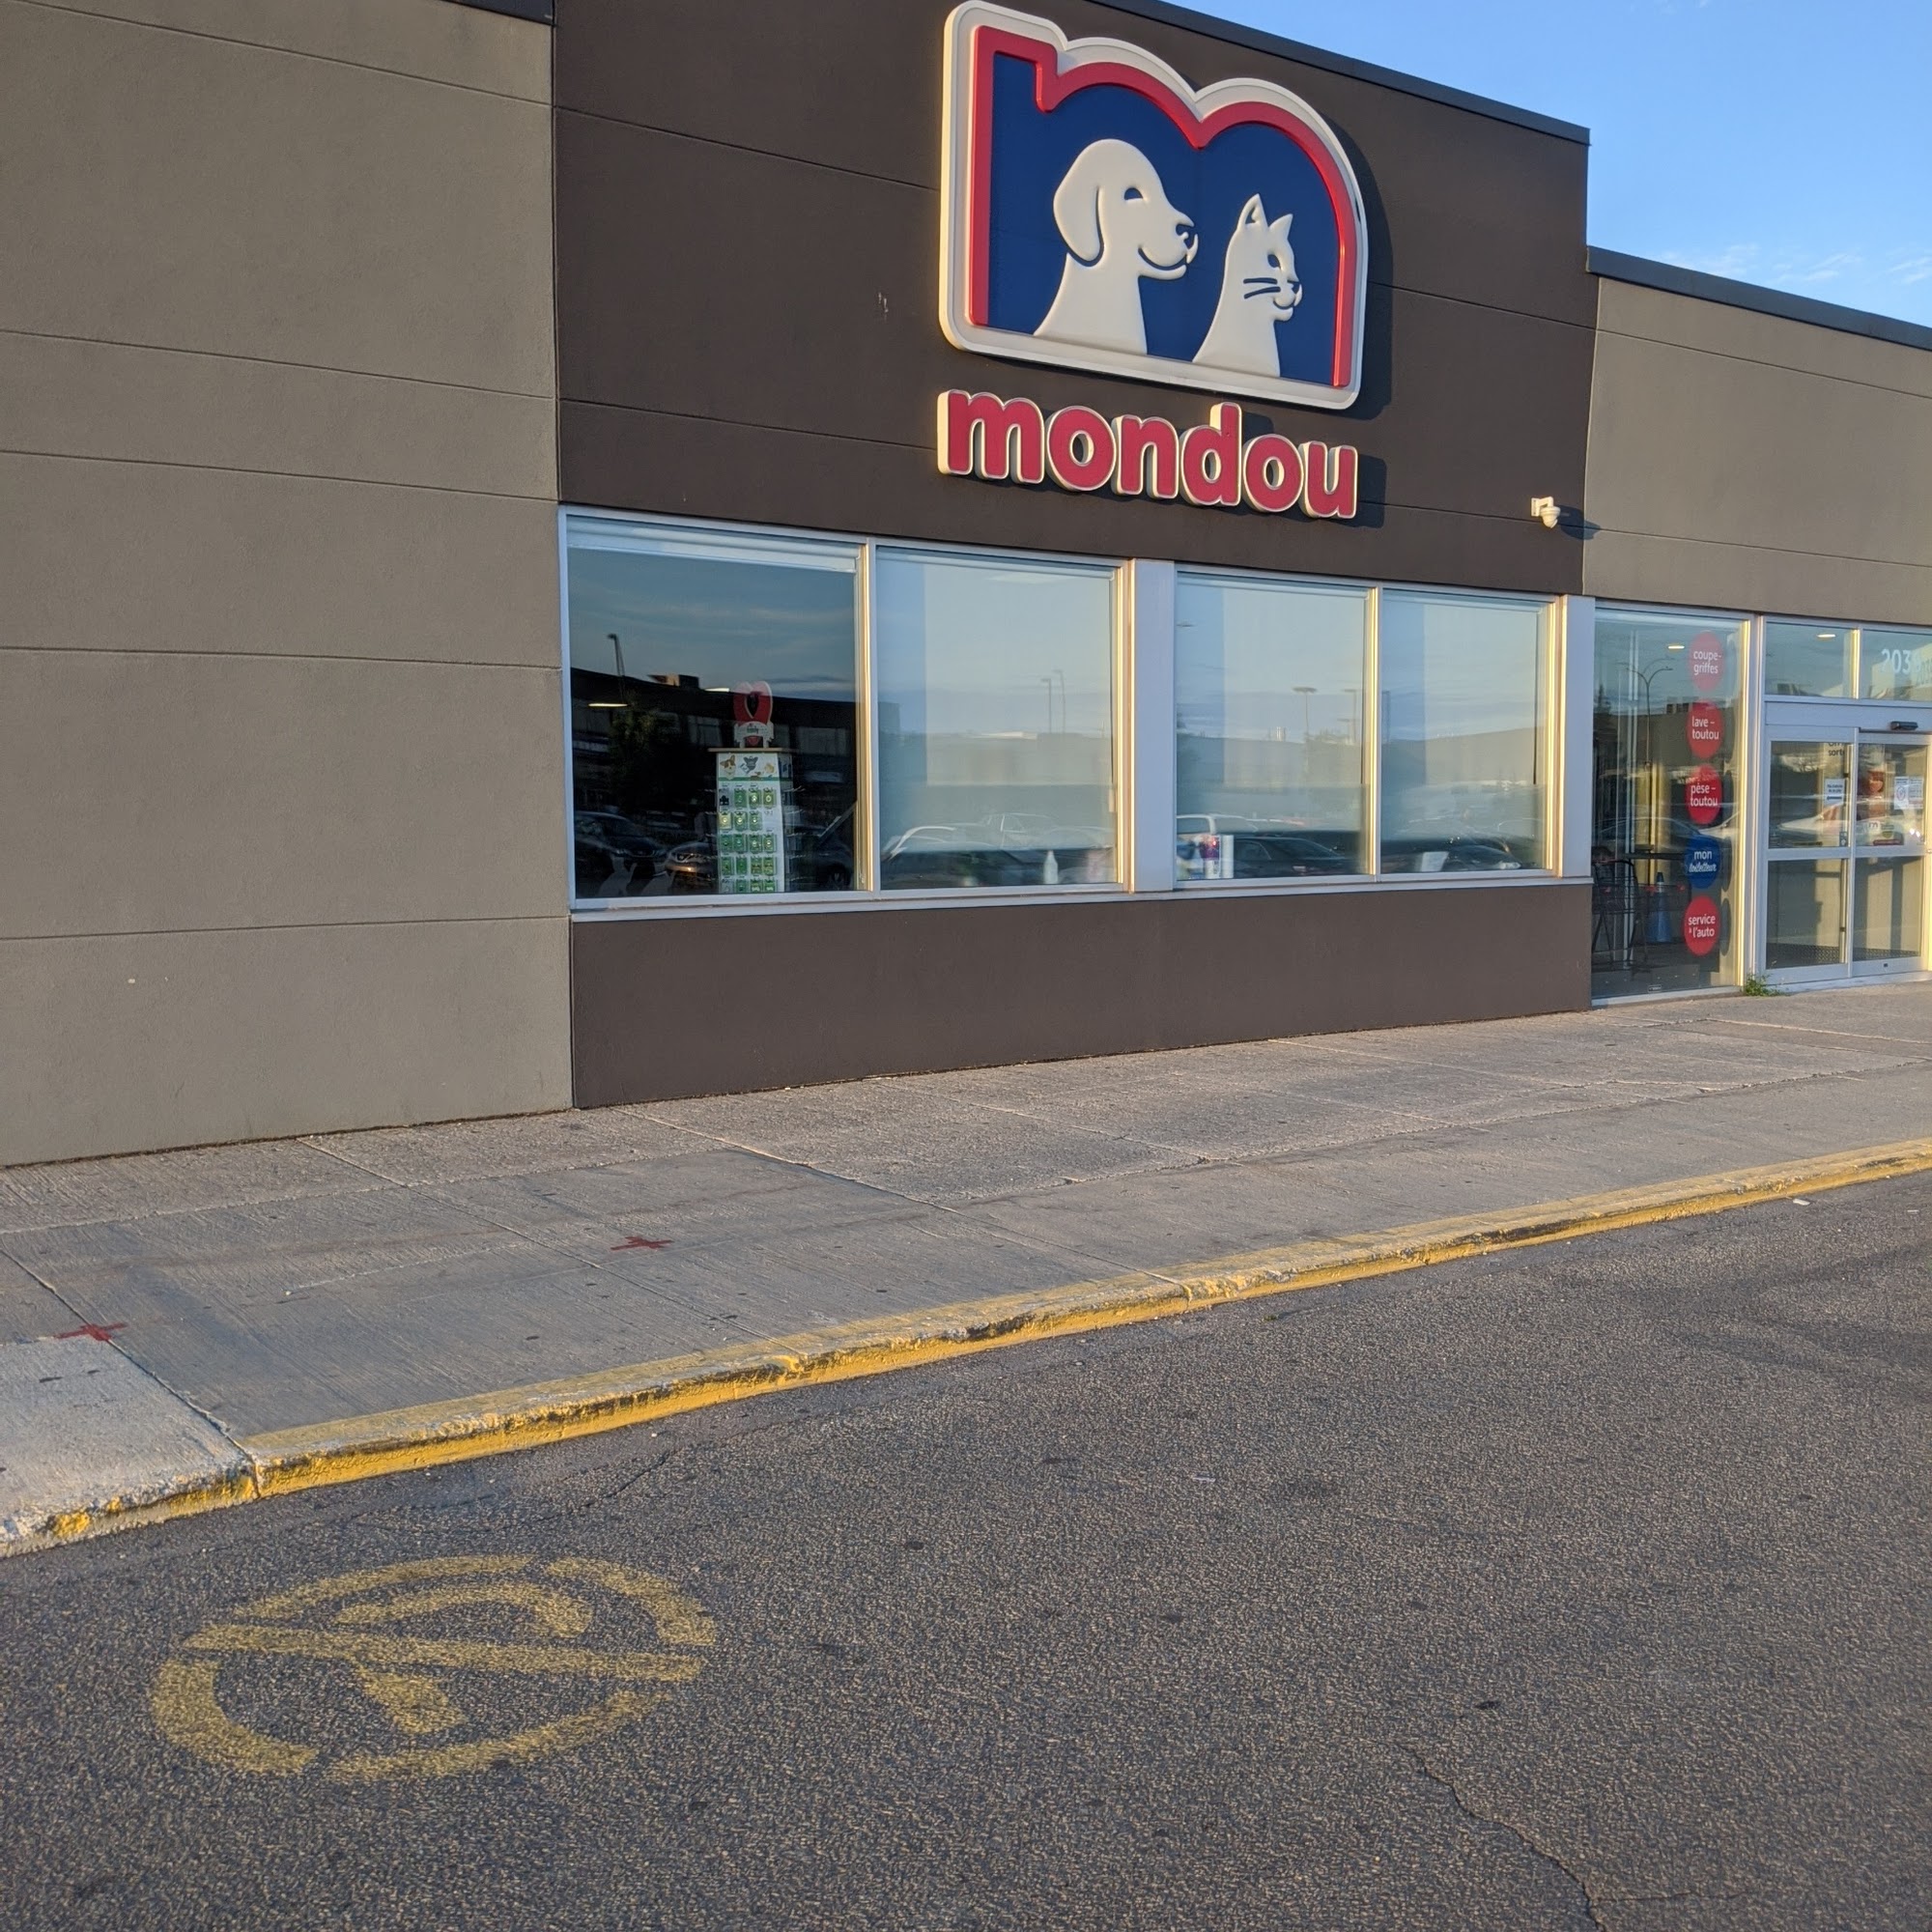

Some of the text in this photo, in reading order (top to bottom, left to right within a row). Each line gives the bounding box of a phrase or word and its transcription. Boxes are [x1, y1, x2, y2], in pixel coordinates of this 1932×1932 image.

[937, 389, 1358, 520] mondou
[1693, 662, 1719, 675] griffes
[1691, 728, 1719, 740] toutou
[1690, 796, 1719, 807] toutou
[1693, 850, 1713, 860] mon
[1688, 914, 1717, 926] service
[1692, 926, 1716, 938] l'auto
